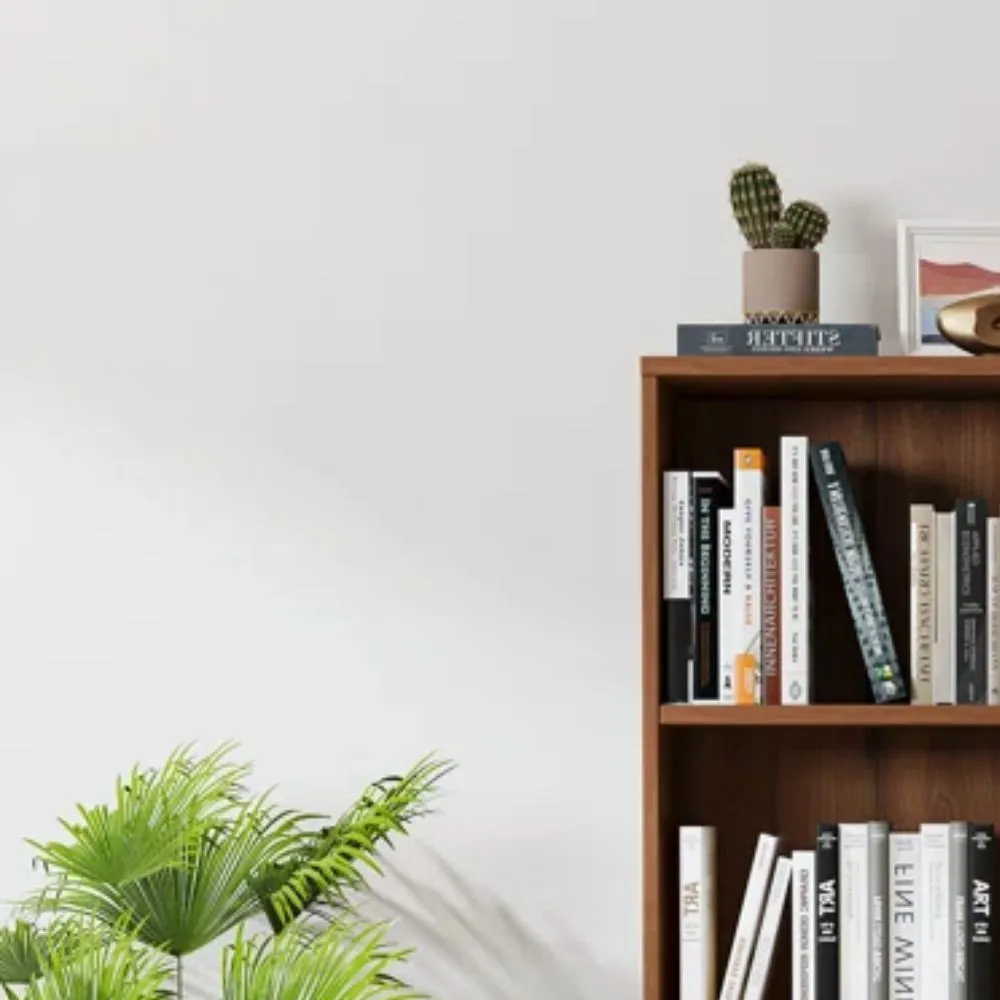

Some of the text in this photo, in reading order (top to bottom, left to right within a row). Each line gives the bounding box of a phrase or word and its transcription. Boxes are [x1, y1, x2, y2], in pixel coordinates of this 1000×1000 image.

[699, 498, 712, 513] IN
[699, 516, 712, 540] THE
[722, 520, 732, 595] MODERN
[699, 543, 712, 615] BEGINNING
[972, 878, 991, 917] ART
